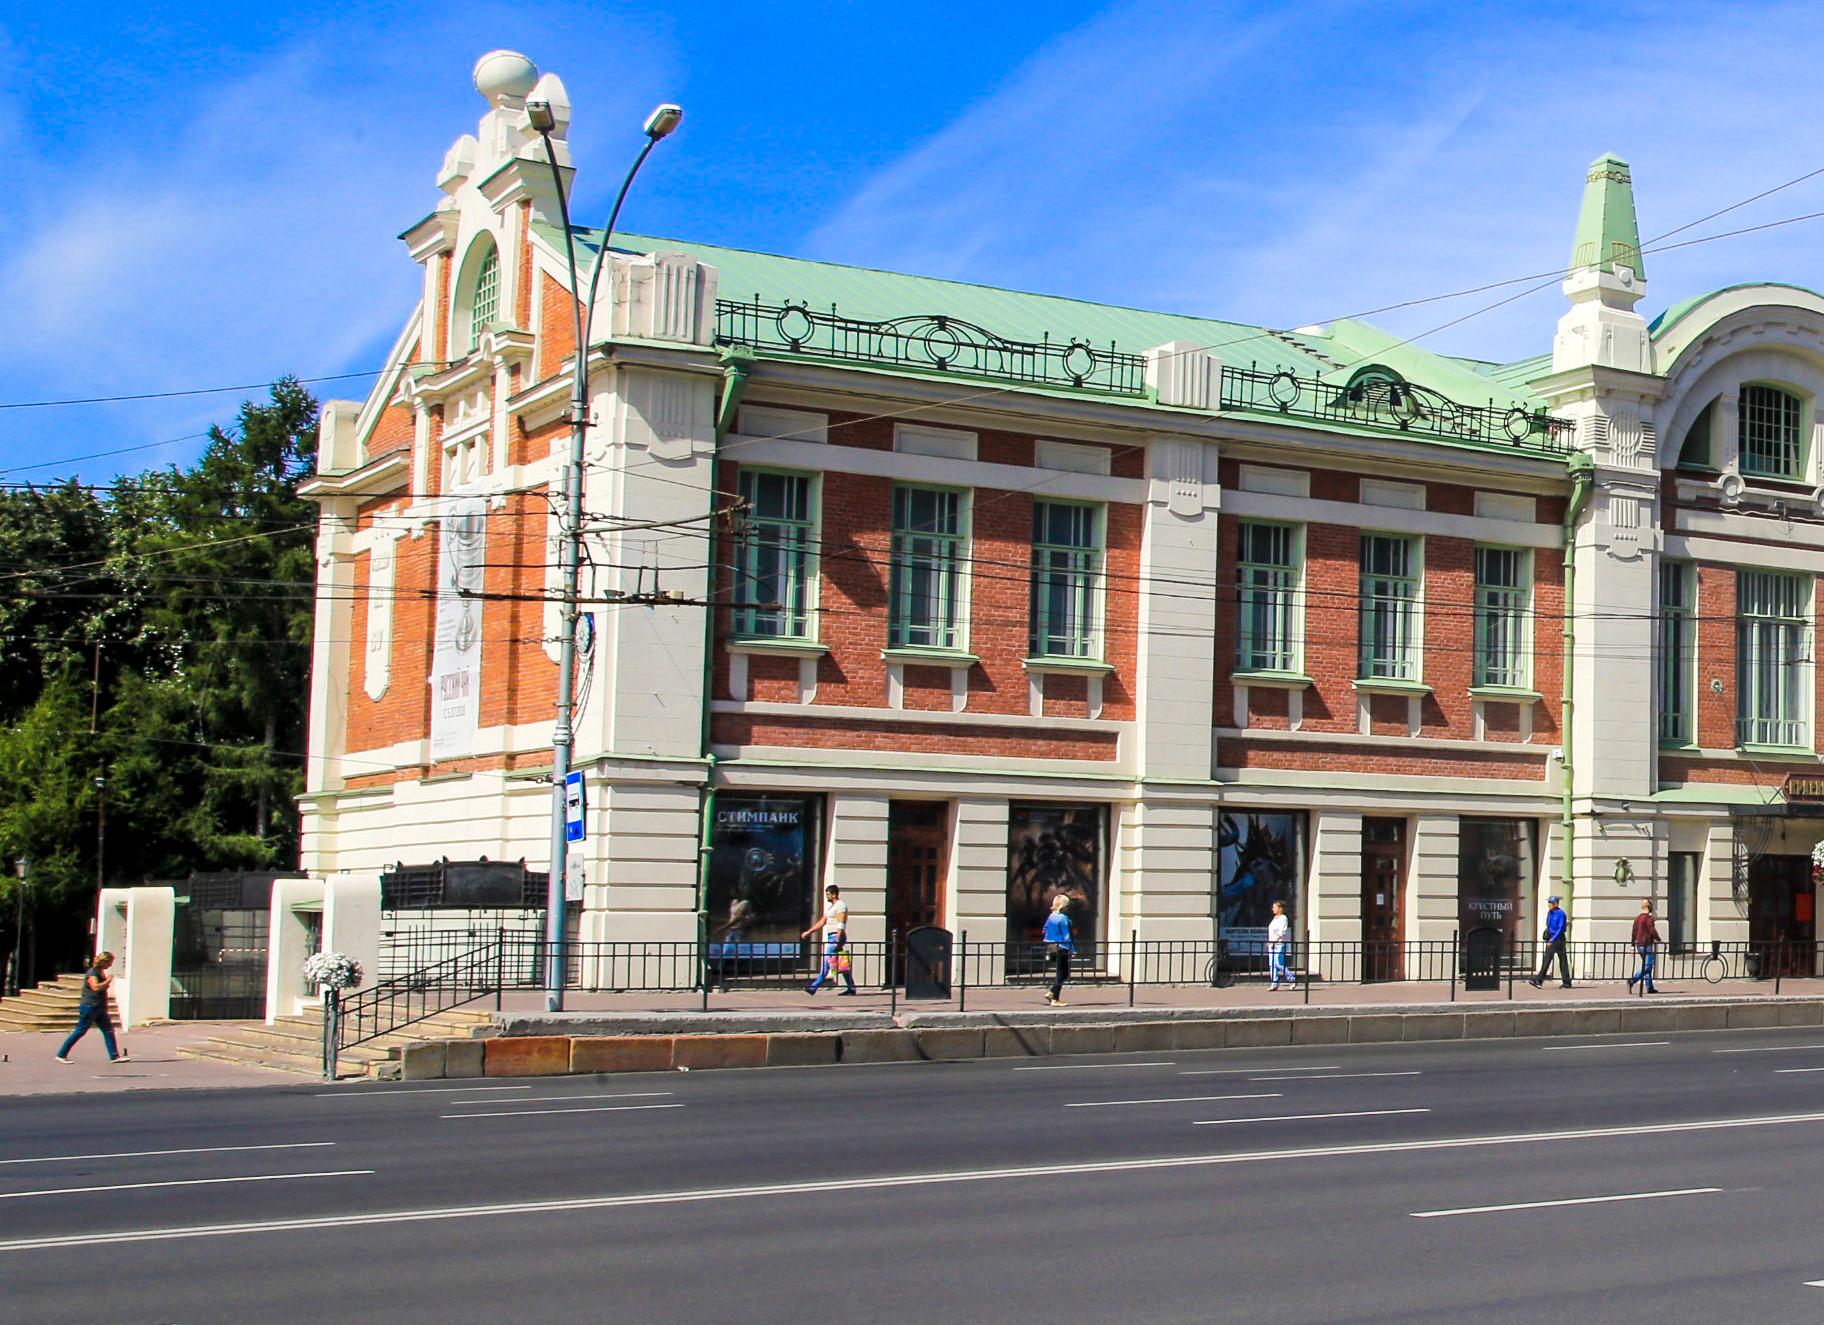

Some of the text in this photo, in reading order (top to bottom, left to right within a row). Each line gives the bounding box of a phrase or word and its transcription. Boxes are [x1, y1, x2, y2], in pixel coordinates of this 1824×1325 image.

[718, 811, 799, 823] СТИМПАНК
[1468, 900, 1513, 911] КРЕСТНЫЙ
[1480, 911, 1502, 920] ПУТЬ
